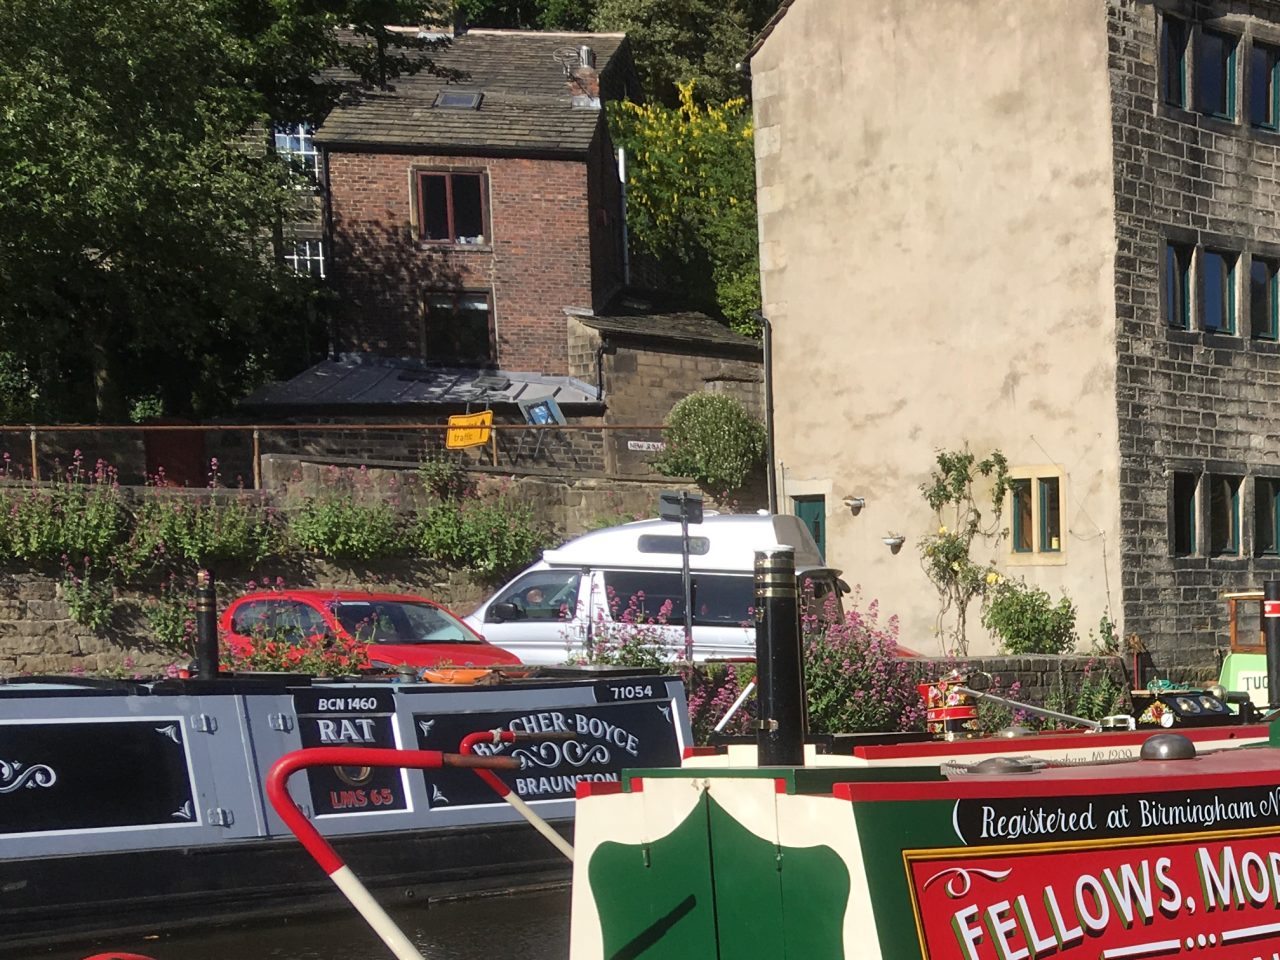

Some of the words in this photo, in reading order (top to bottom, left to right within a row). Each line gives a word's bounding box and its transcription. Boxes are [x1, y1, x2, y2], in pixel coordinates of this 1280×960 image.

[610, 685, 653, 699] 71054
[318, 698, 344, 710] BCN
[347, 697, 377, 710] 1460
[316, 718, 377, 743] RAT
[330, 789, 368, 809] LMS
[370, 788, 394, 806] 65
[980, 806, 1098, 841] Registered
[1105, 803, 1131, 829] at
[1139, 797, 1258, 829] Birmingham
